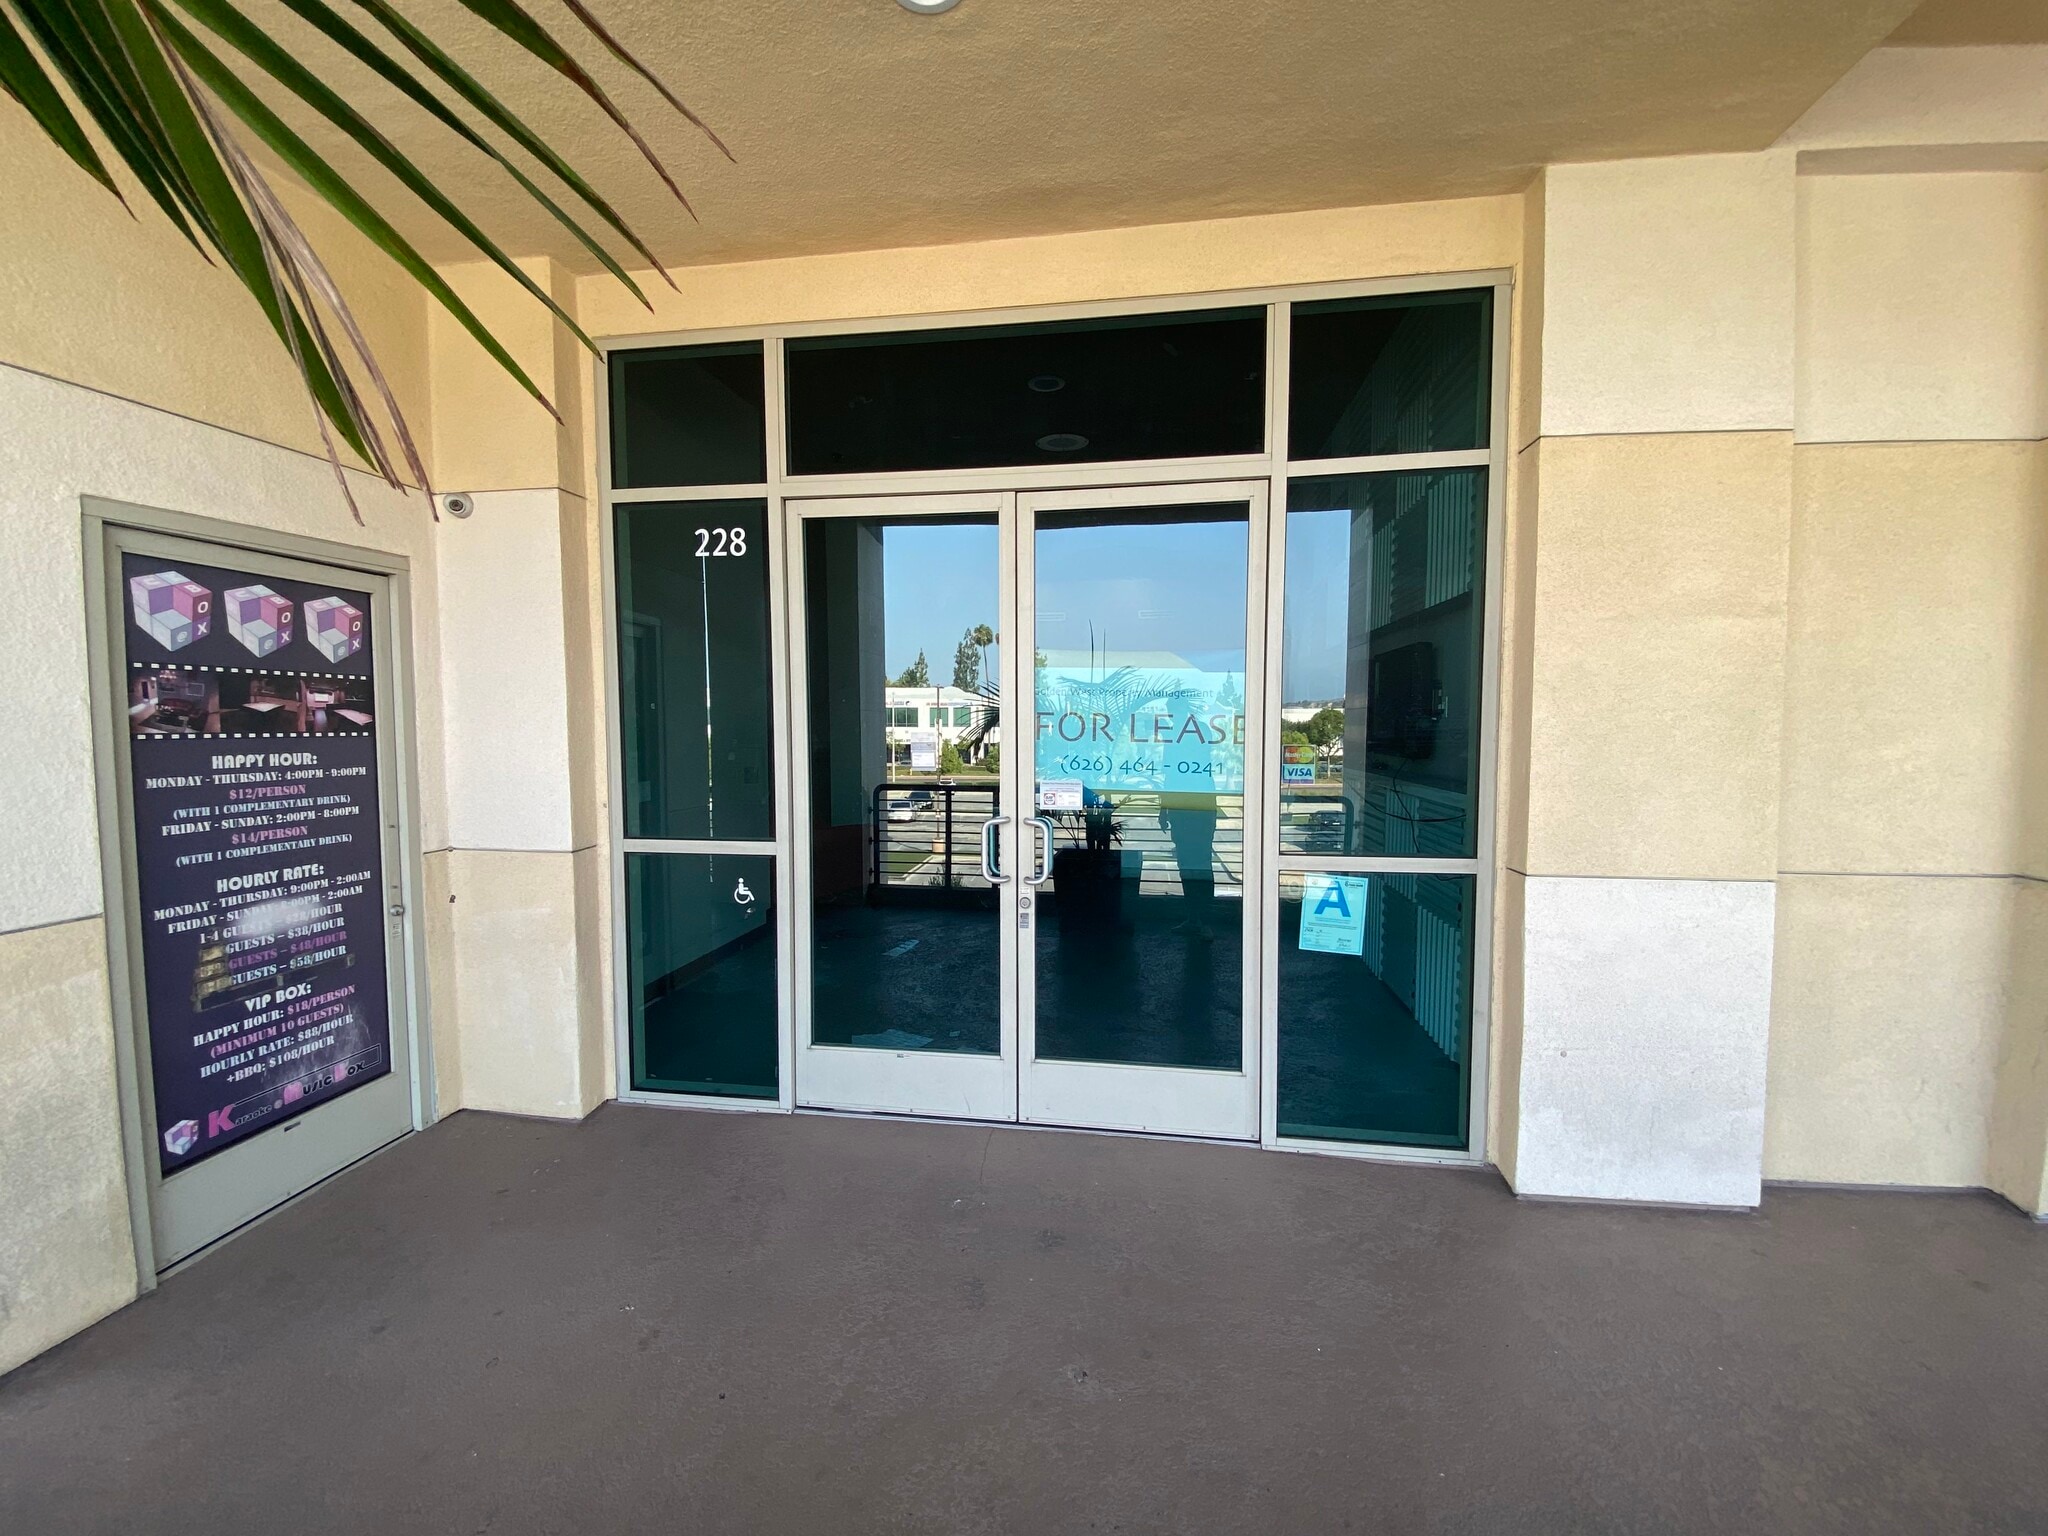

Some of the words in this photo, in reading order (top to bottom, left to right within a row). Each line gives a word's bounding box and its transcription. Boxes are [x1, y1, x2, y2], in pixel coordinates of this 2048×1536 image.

[694, 527, 747, 557] 228
[1144, 688, 1214, 699] Management
[1036, 712, 1114, 743] FOR
[1130, 713, 1245, 745] LEASE
[212, 754, 266, 769] HAPPY
[269, 752, 318, 767] HOUR:
[1060, 754, 1113, 775] (626)
[1119, 755, 1158, 775] 464
[1177, 760, 1224, 778] 0241
[1287, 768, 1312, 777] VISA
[146, 776, 203, 789] MONDAY
[212, 771, 282, 785] THURSDAY:
[285, 769, 323, 780] 4:00PM
[331, 767, 366, 777] 9:00PM
[229, 784, 306, 800] $12/PERSON
[162, 821, 212, 836] FRIDAY
[221, 815, 274, 830] SUNDAY:
[276, 810, 316, 823] 2:00PM
[323, 805, 360, 818] 8:00PM
[173, 806, 211, 820] (WITH
[223, 797, 315, 814] COMPLEMENTARY
[317, 794, 351, 805] DRINK)
[175, 852, 213, 867] (WITH
[226, 838, 317, 859] COMPLEMENTARY
[319, 833, 353, 846] DRINK)
[231, 825, 308, 844] $14/PERSON
[217, 870, 280, 893] HOURLY
[283, 863, 325, 879] RATE:
[154, 901, 210, 921] MONDAY
[219, 886, 288, 908] THURSDAY:
[290, 879, 329, 894] 9:00PM
[336, 870, 371, 885] 2:00AM
[168, 915, 218, 934] FRIDAY
[327, 885, 363, 900] 2:00AM
[1314, 880, 1351, 918] A
[200, 931, 219, 944] 1-4
[226, 934, 275, 954] GUESTS
[288, 917, 345, 939] $38/HOUR
[229, 948, 278, 970] GUESTS
[290, 931, 347, 953] $48/HOUR
[231, 964, 277, 985] GUESTS
[290, 945, 347, 969] $58/HOUR
[245, 994, 271, 1013] VIP
[276, 982, 312, 1003] BOX:
[193, 1022, 240, 1047] HAPPY
[243, 1009, 284, 1029] HOUR:
[287, 984, 356, 1015] $18/PERSON
[210, 1026, 277, 1059] (MINIMUM
[280, 1020, 295, 1036] 10
[297, 1003, 344, 1026] GUESTS)
[200, 1051, 256, 1078] HOURLY
[258, 1036, 295, 1057] RATE:
[298, 1013, 354, 1042] $88/HOUR
[227, 1062, 266, 1084] +BBQ:
[268, 1035, 335, 1069] $108/HOUR
[208, 1104, 272, 1138] Karaoke
